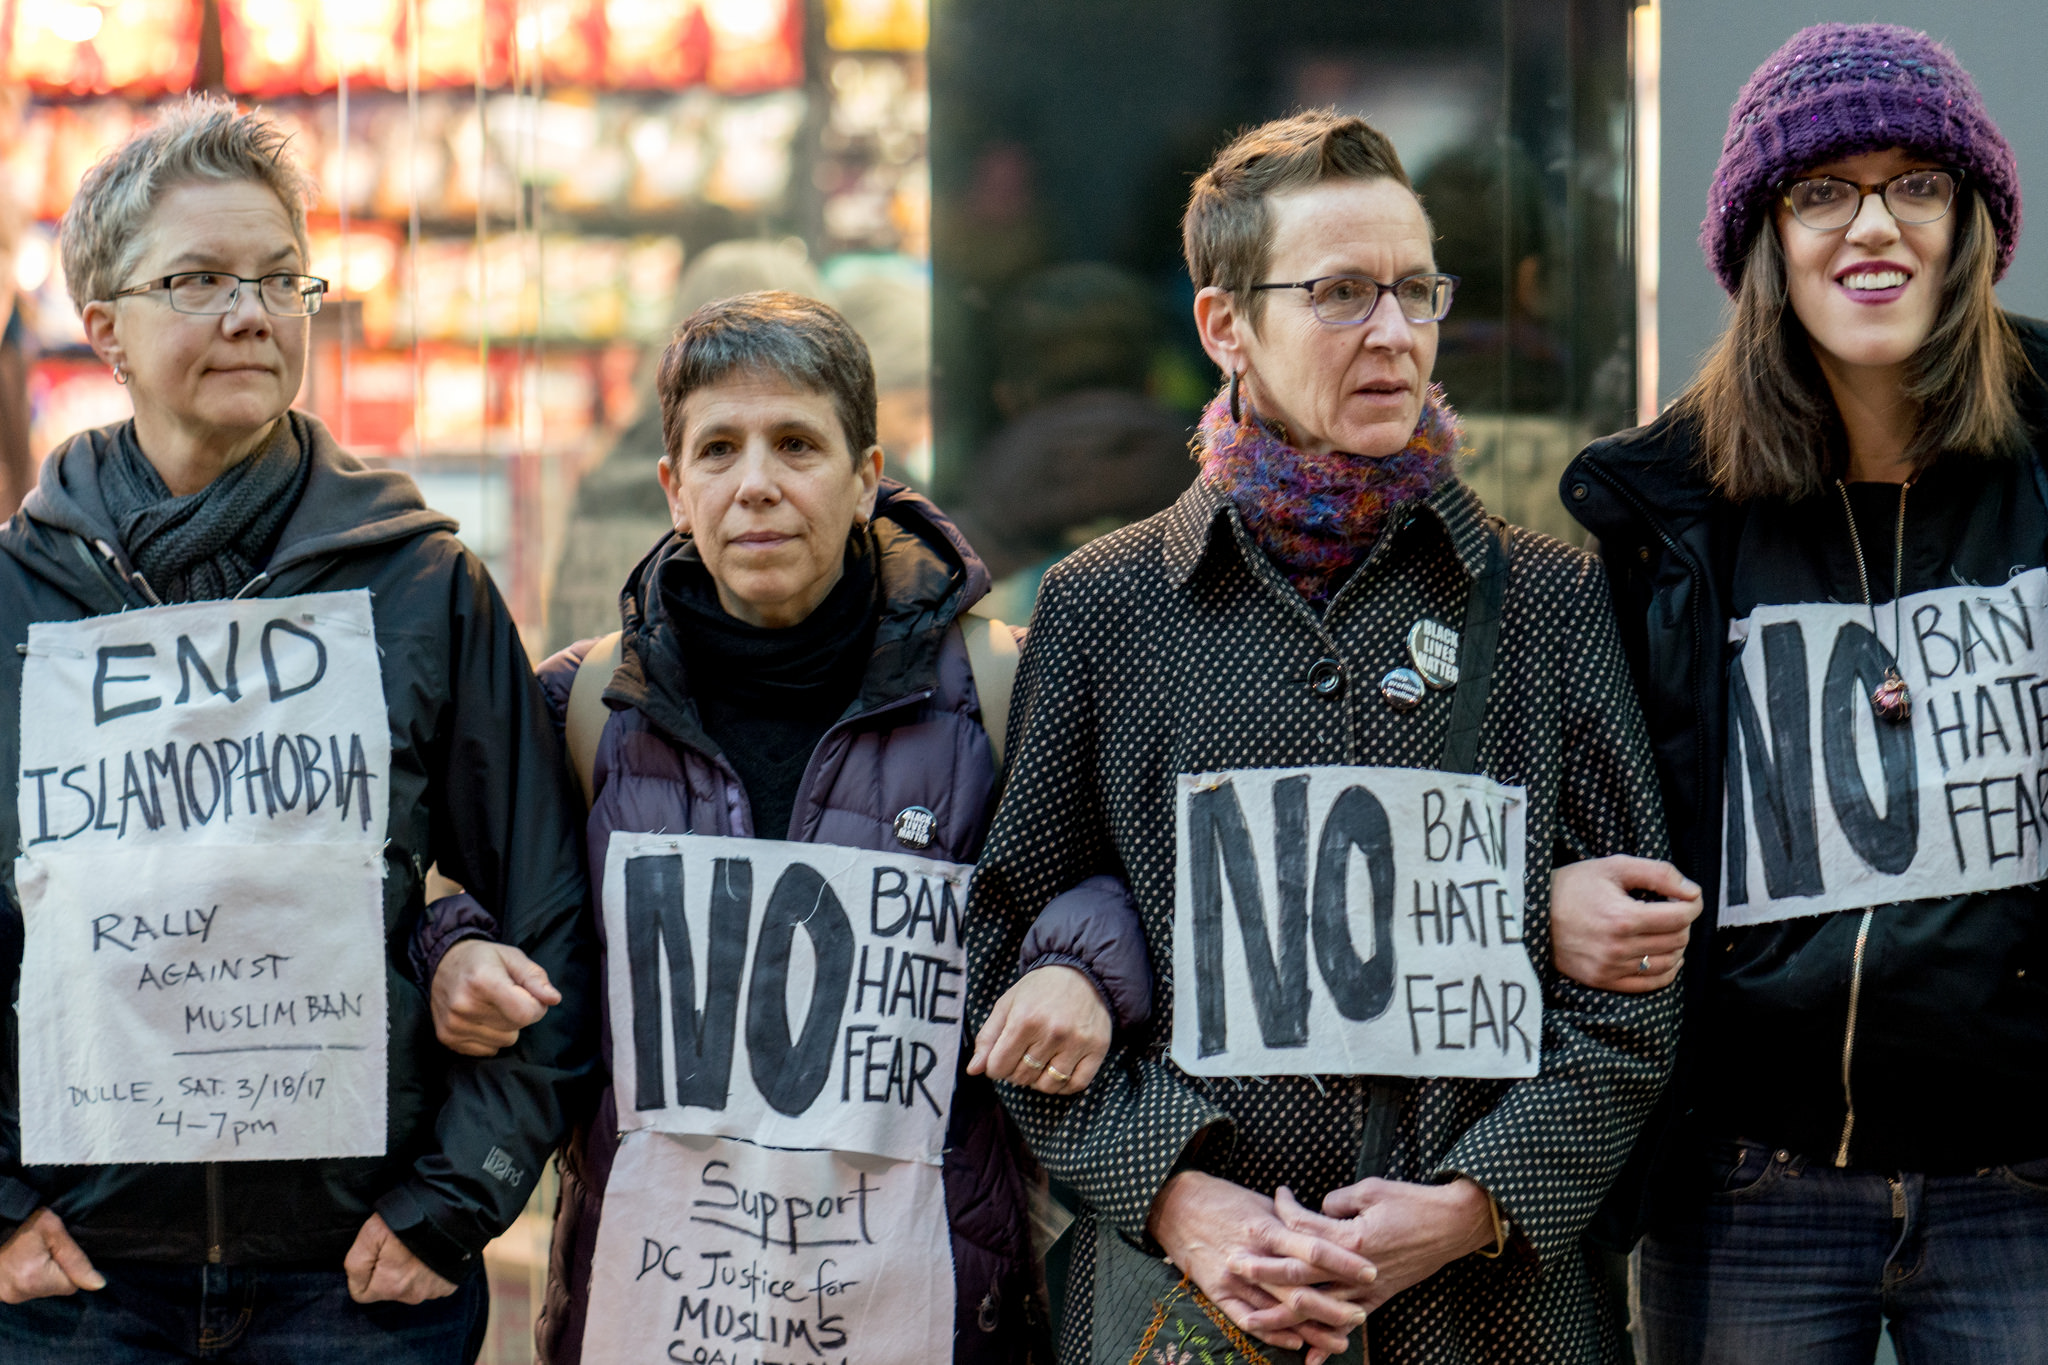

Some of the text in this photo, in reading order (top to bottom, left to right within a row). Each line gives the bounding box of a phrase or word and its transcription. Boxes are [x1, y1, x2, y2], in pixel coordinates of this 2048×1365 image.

[94, 619, 327, 726] END
[1417, 651, 1459, 683] MATTER
[1423, 619, 1459, 648] BLACK
[1423, 636, 1457, 664] LIVES
[1911, 586, 2034, 687] BAN
[1727, 620, 1919, 906] NO
[1927, 674, 2048, 772] HATE
[23, 731, 377, 846] ISLAMOPHOBIA
[1422, 789, 1509, 872] BAN
[93, 905, 219, 951] RALLY
[871, 867, 966, 949] BAN
[1190, 775, 1395, 1060] NO
[1408, 879, 1523, 947] HATE
[138, 955, 290, 991] AGAINST
[185, 993, 363, 1035] MUSLIM BAN
[626, 855, 854, 1118] NO
[854, 946, 963, 1024] HATE
[1405, 974, 1532, 1063] FEAR
[178, 1076, 226, 1097] SAT.
[237, 1072, 326, 1111] 3/18/17
[840, 1024, 943, 1117] FEAR
[694, 1160, 881, 1253] Support
[635, 1237, 859, 1319] DC Justice for
[673, 1295, 848, 1356] MUSLIMS
